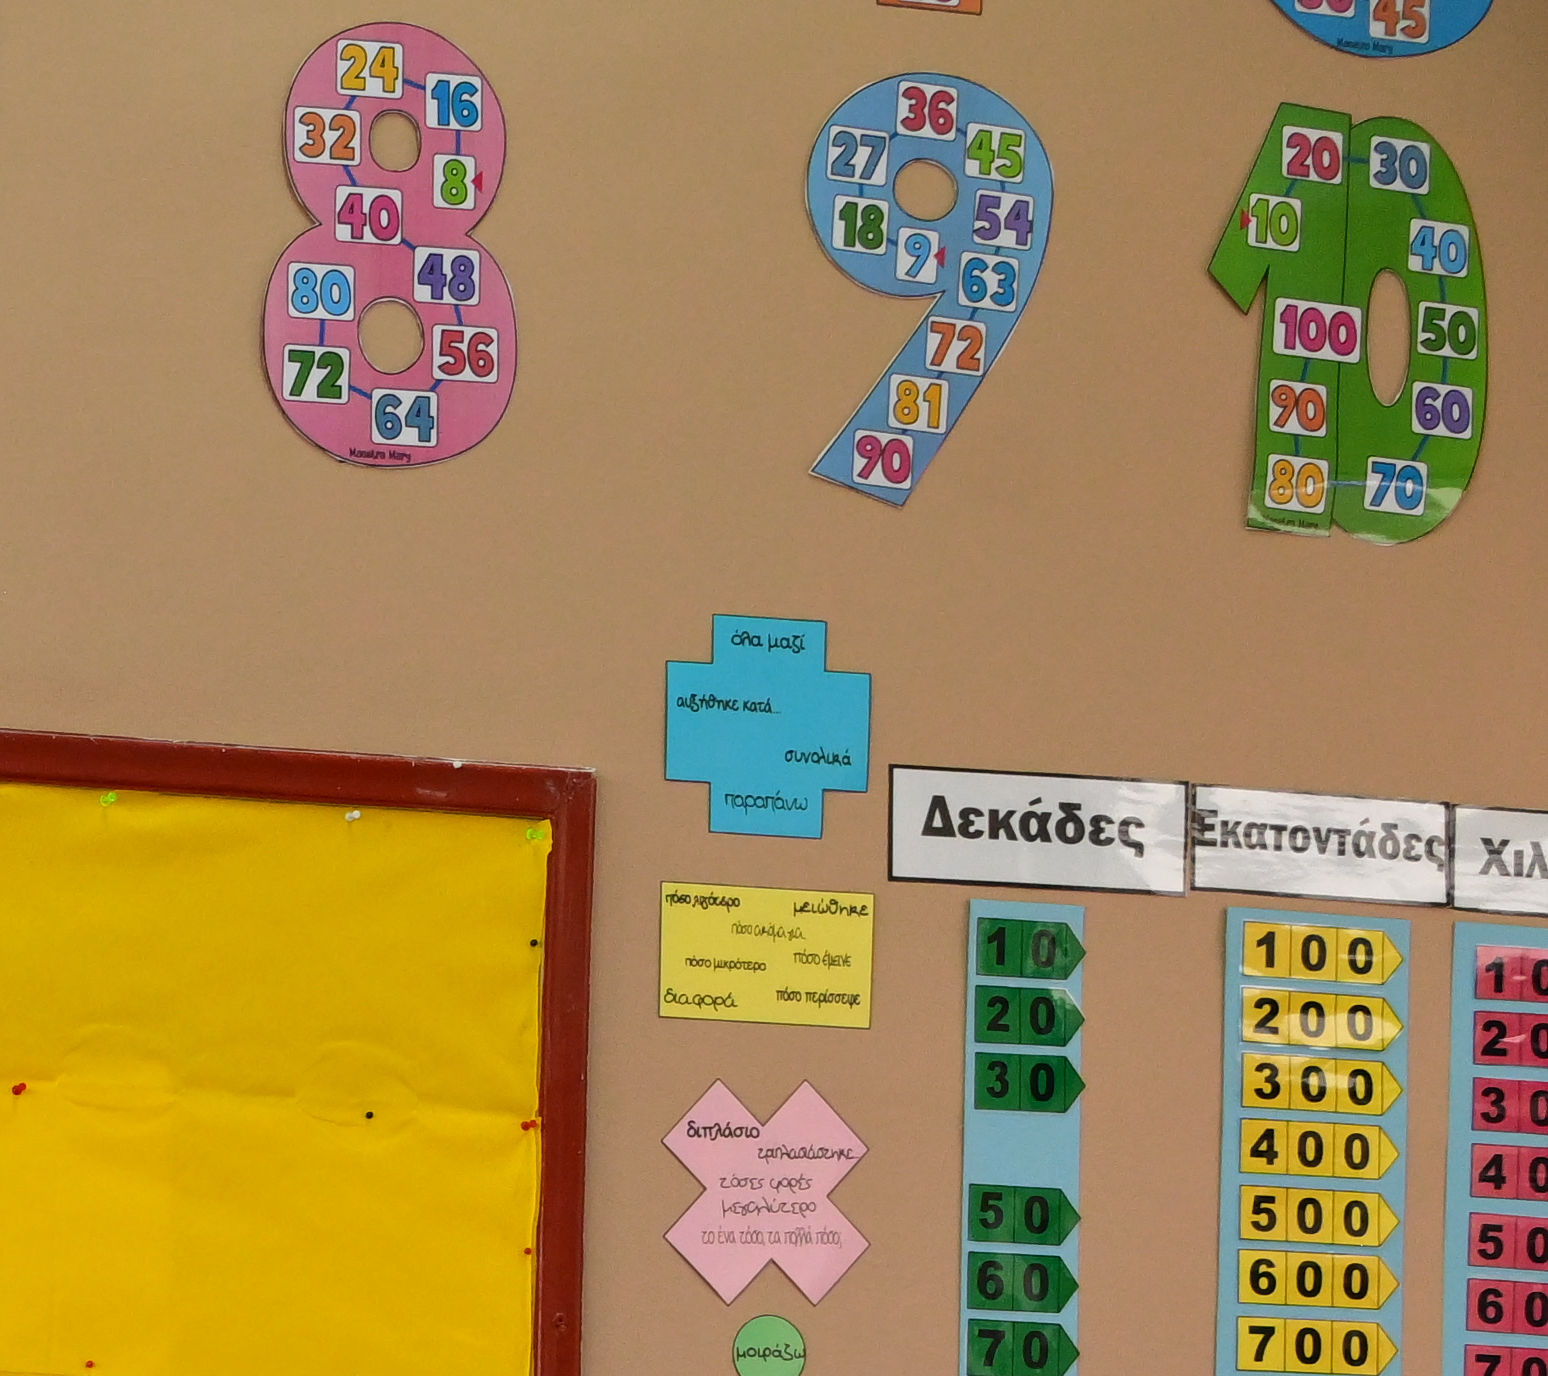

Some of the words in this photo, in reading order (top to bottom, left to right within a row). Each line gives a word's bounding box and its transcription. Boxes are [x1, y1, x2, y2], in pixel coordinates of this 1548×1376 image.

[431, 79, 479, 127] 16
[900, 86, 955, 136] 36
[1286, 132, 1341, 181] 20
[1372, 140, 1427, 190] 30
[337, 193, 399, 241] 40
[1279, 304, 1357, 356] 100
[288, 350, 345, 399] 72
[893, 379, 942, 429] 81
[1268, 458, 1325, 509] 80
[731, 629, 764, 648] όλα
[767, 633, 806, 654] μαζί
[676, 693, 739, 713] αυξήθηκε
[784, 746, 852, 767] συνολικά
[724, 790, 808, 815] παραπάνω
[921, 795, 1145, 858] Δεκάδες
[1193, 808, 1445, 872] Εκατοντάδες
[793, 898, 869, 918] μειώθηκε
[685, 955, 712, 969] πόσο
[713, 957, 767, 974] μικρότερο
[793, 948, 821, 965] πόσο
[987, 926, 1056, 969] 10
[1256, 931, 1374, 975] 100
[663, 988, 738, 1012] διαφορά
[776, 986, 802, 1003] πόσο
[986, 1060, 1055, 1102] 30
[686, 1120, 760, 1141] διπλάσιο
[1250, 1128, 1370, 1171] 400
[719, 1173, 765, 1190] τόσες
[769, 1173, 813, 1193] φορές
[736, 1343, 806, 1363] μοιράζω
[977, 1329, 1049, 1370] 70
